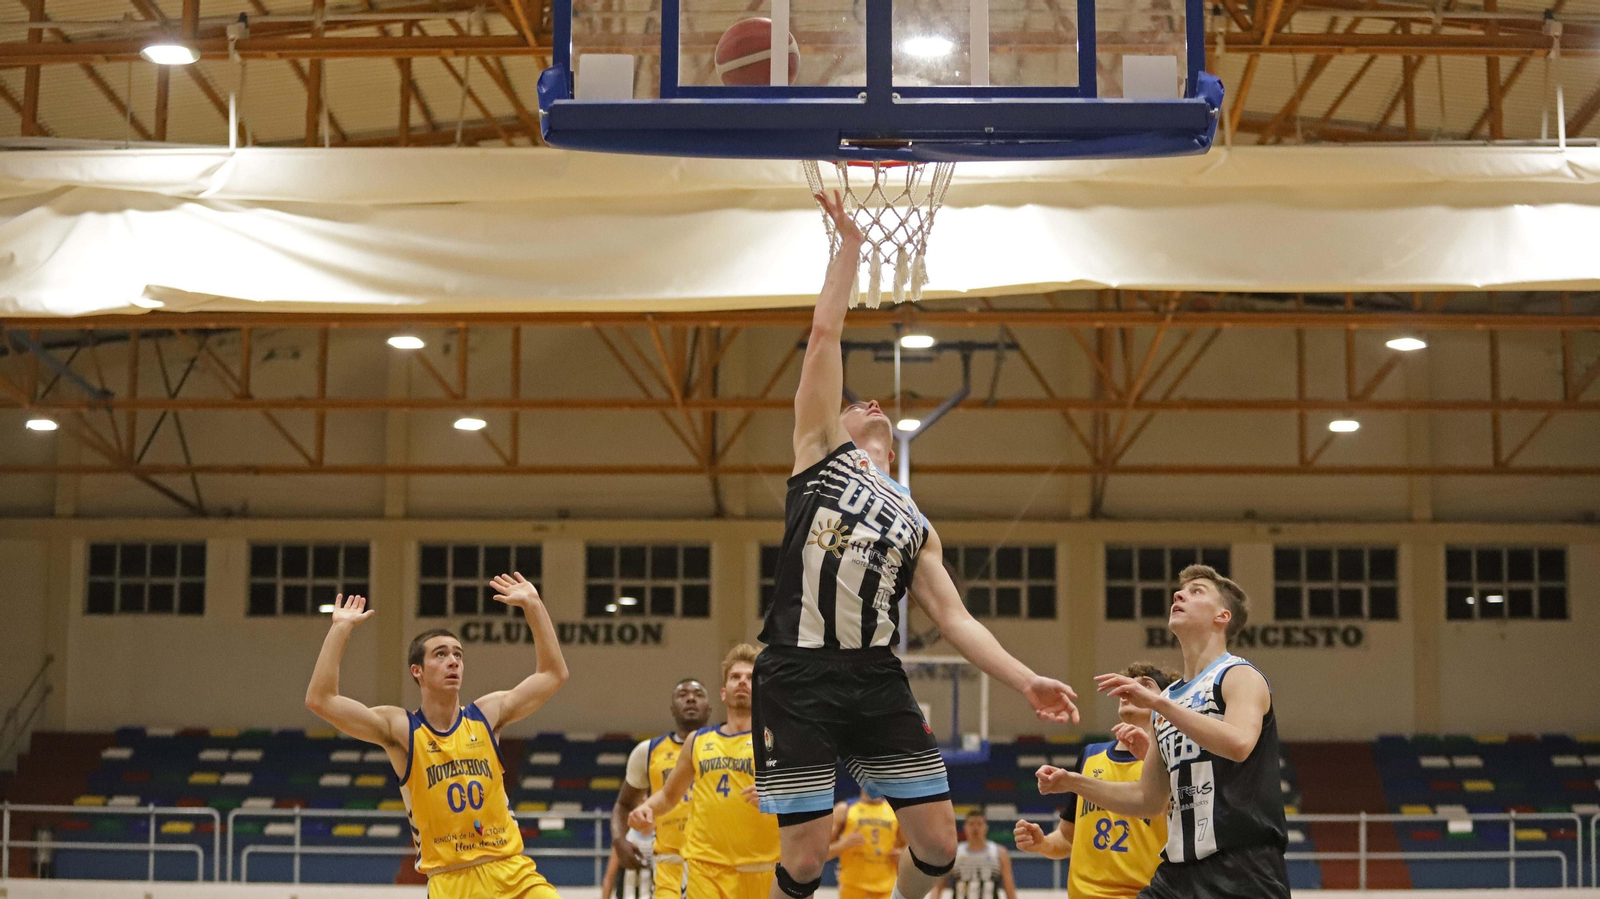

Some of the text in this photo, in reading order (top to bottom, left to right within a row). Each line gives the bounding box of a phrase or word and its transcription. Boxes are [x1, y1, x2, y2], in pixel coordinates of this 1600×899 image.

[838, 478, 914, 549] ULB
[557, 622, 664, 645] UNION
[1146, 625, 1364, 648] BNCESTO
[426, 759, 493, 789] NOVASCHOOL
[699, 757, 755, 779] NOVASCHOOL
[447, 780, 484, 813] 00
[716, 774, 731, 798] 4
[1093, 818, 1130, 852] 82
[1197, 817, 1209, 841] 7
